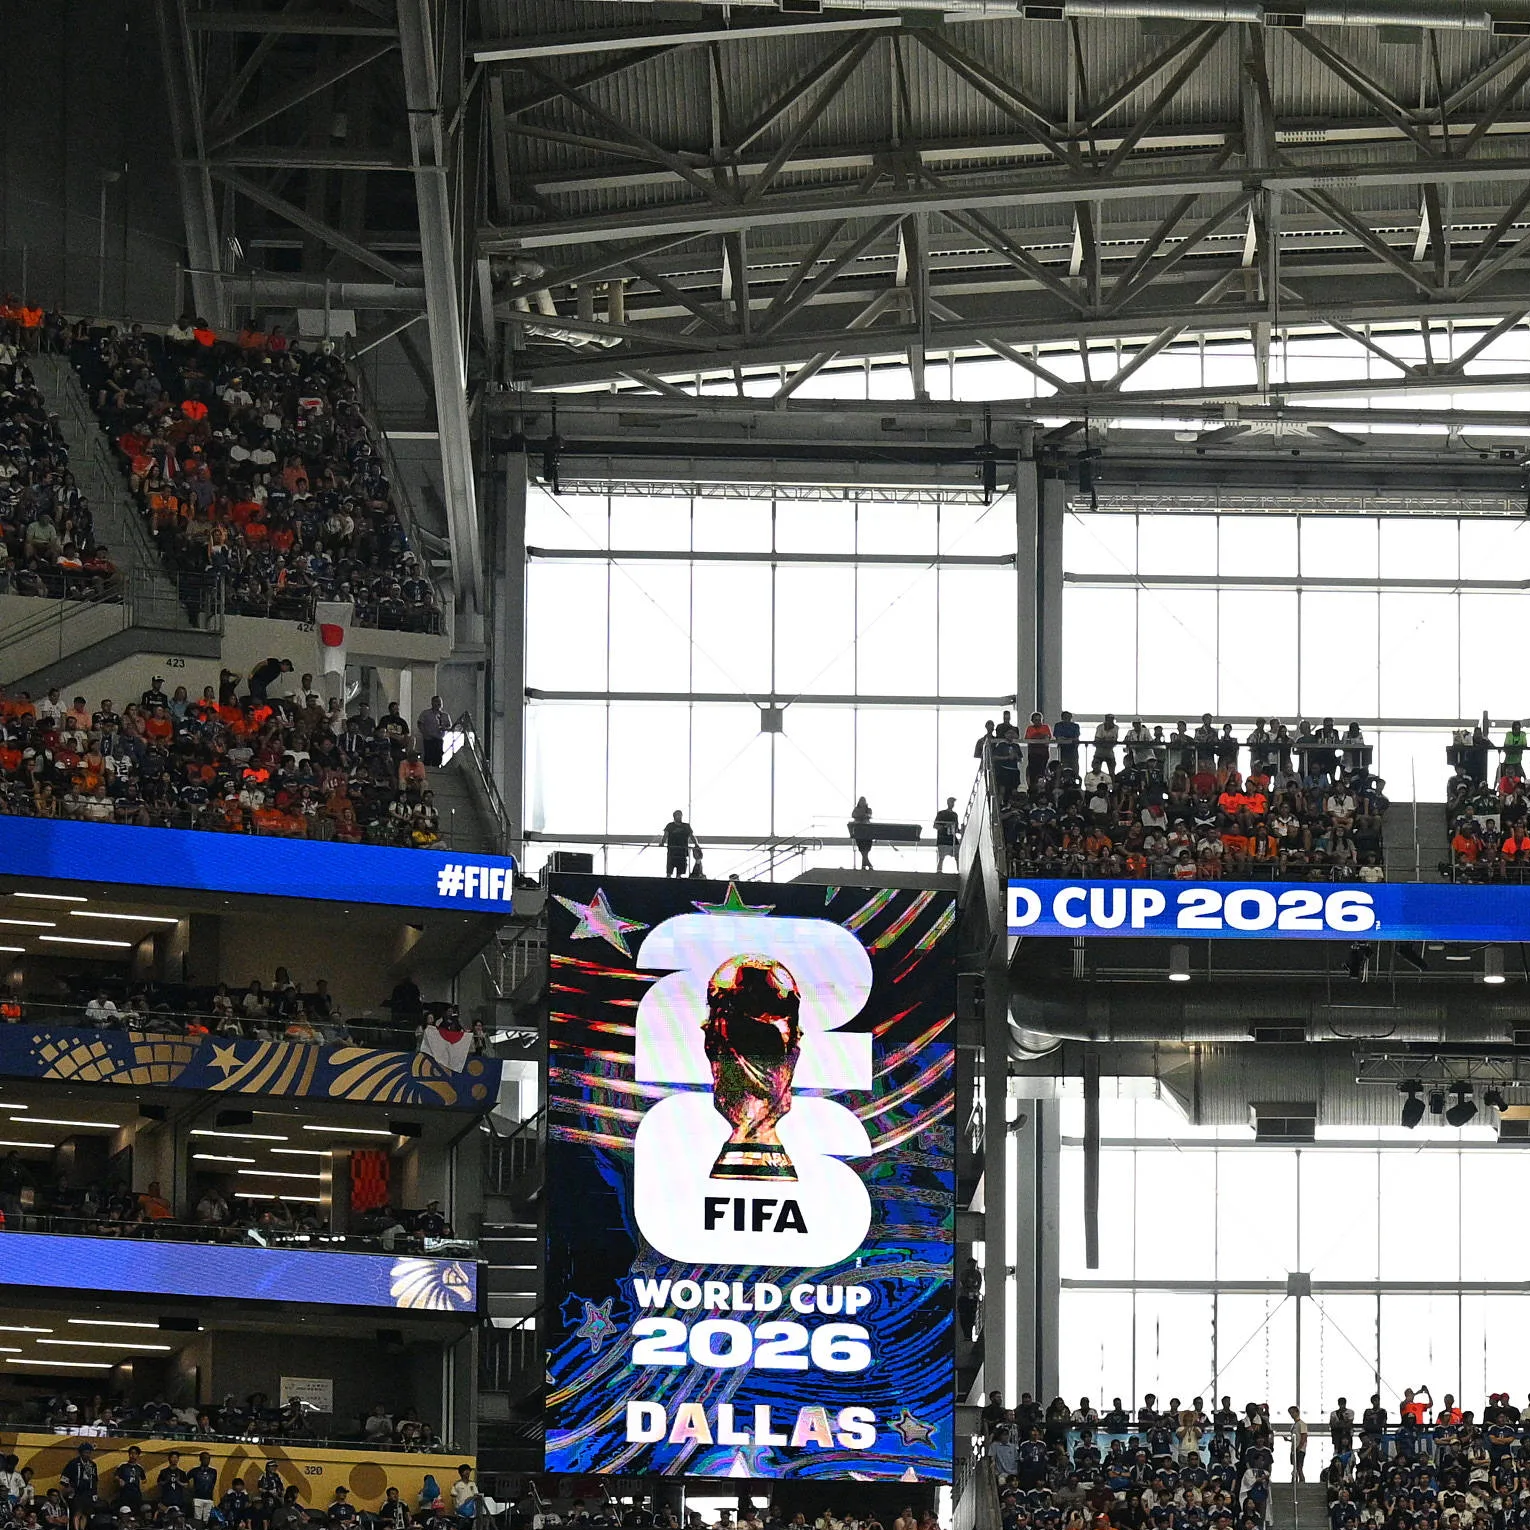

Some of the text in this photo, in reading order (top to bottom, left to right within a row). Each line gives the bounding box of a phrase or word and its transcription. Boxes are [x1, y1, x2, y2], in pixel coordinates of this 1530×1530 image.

[166, 658, 185, 668] 423
[436, 863, 512, 902] #FIF
[1053, 885, 1166, 930] CUP
[1176, 888, 1376, 933] 2026
[704, 1197, 808, 1234] FIFA
[634, 1278, 872, 1315] WORLD CUP
[630, 1319, 872, 1374] 2026
[625, 1400, 878, 1450] DALLAS
[304, 1465, 323, 1476] 320
